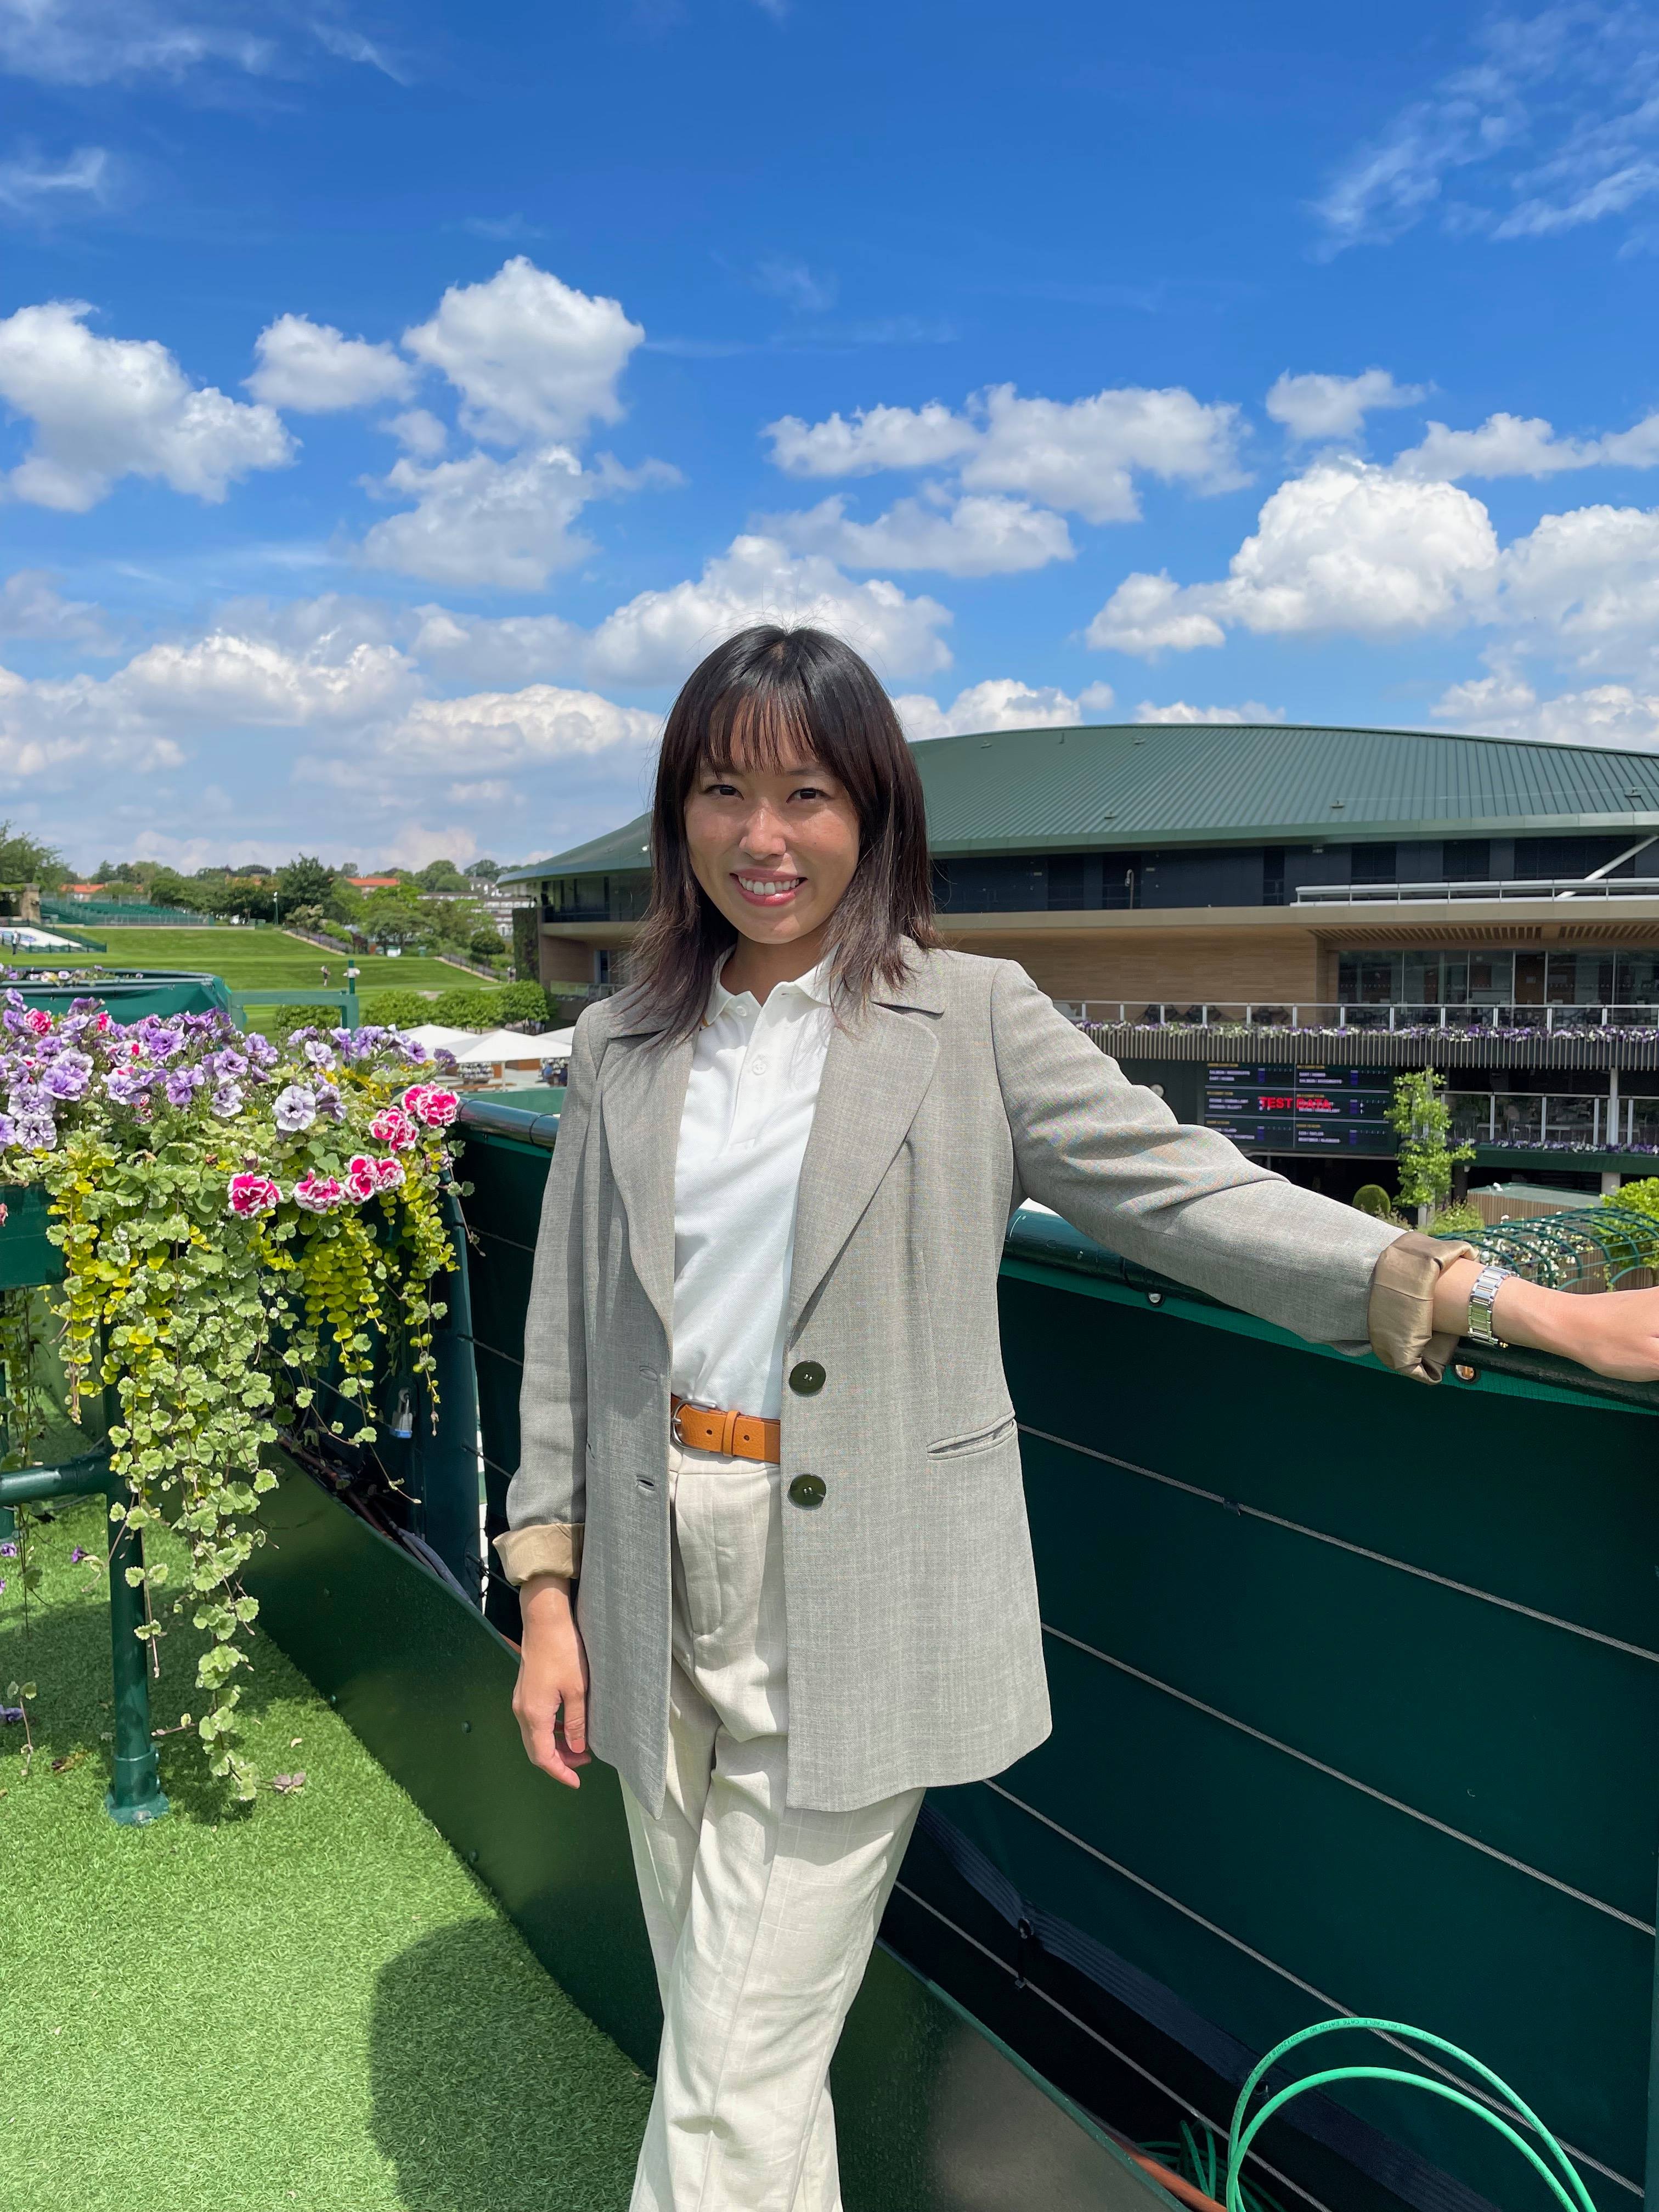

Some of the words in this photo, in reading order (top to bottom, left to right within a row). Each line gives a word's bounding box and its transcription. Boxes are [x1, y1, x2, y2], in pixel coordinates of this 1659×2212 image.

[1259, 1096, 1293, 1109] TEST
[1296, 1098, 1332, 1110] DATA
[1318, 2020, 1340, 2030] BATCH
